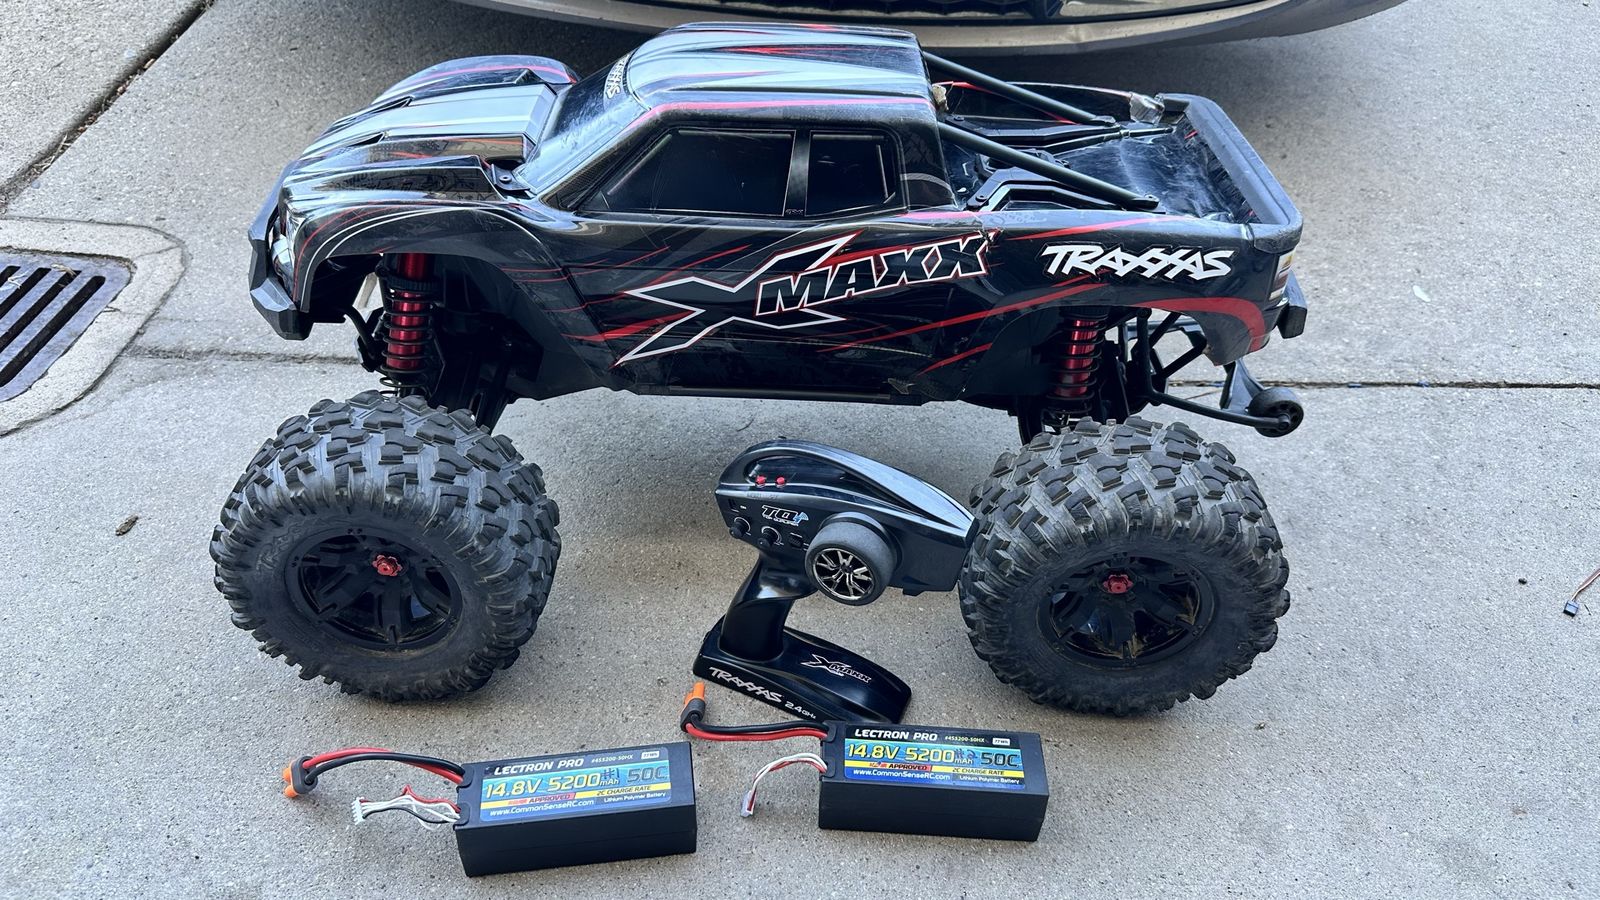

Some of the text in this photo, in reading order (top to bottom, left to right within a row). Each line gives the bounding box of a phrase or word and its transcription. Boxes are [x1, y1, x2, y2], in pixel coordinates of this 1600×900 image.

[1041, 245, 1235, 281] TRAXXAS
[709, 667, 782, 703] TRAXXAS
[855, 729, 909, 740] LECTRON
[913, 732, 938, 741] PRO
[849, 744, 899, 760] 14.8V
[905, 747, 955, 763] 5200
[981, 752, 1019, 767] 50C
[494, 761, 554, 776] LECTRON
[557, 758, 585, 769] PRO
[888, 763, 928, 771] APPROVED
[853, 769, 951, 780] www.CommonSenseRC.com
[486, 779, 542, 799] 14.8V
[547, 773, 601, 792] 5200
[627, 766, 669, 783] 50C
[607, 787, 634, 795] CHARGE
[624, 793, 645, 801] Polymer
[528, 794, 571, 804] APPROVED
[490, 800, 594, 816] www.CommonSenseRC.com
